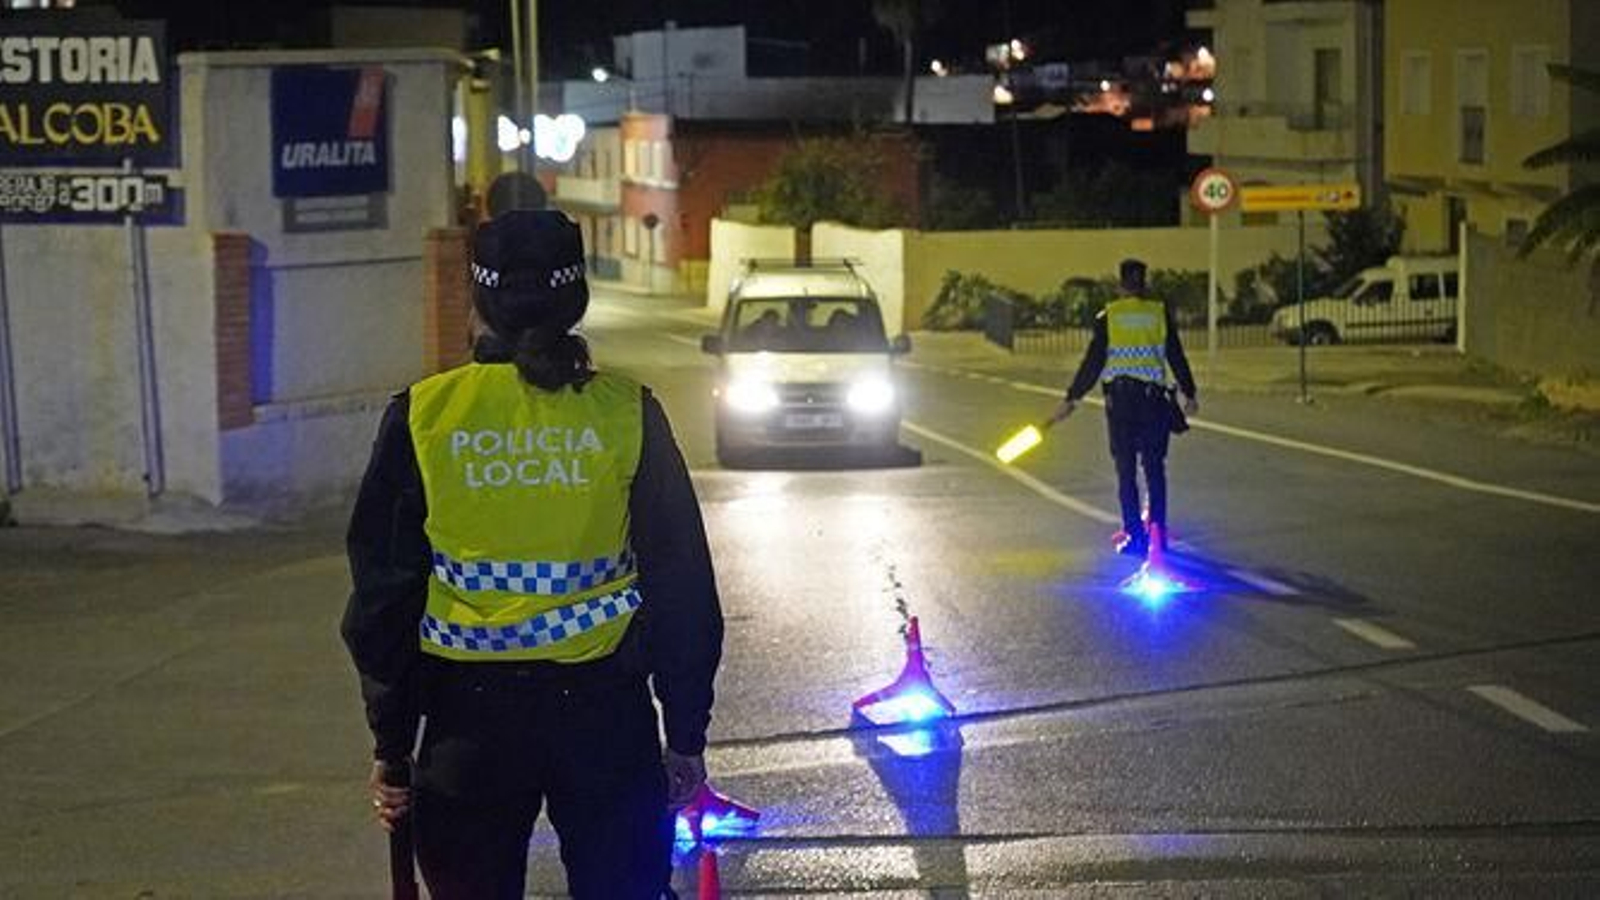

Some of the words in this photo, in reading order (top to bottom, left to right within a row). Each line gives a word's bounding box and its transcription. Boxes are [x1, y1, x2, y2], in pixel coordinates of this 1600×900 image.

[0, 37, 160, 83] STORIA
[0, 103, 159, 144] ALCOBA
[281, 141, 376, 169] URALITA
[1203, 182, 1228, 200] 40
[452, 427, 604, 458] POLICIA
[464, 459, 589, 488] LOCAL
